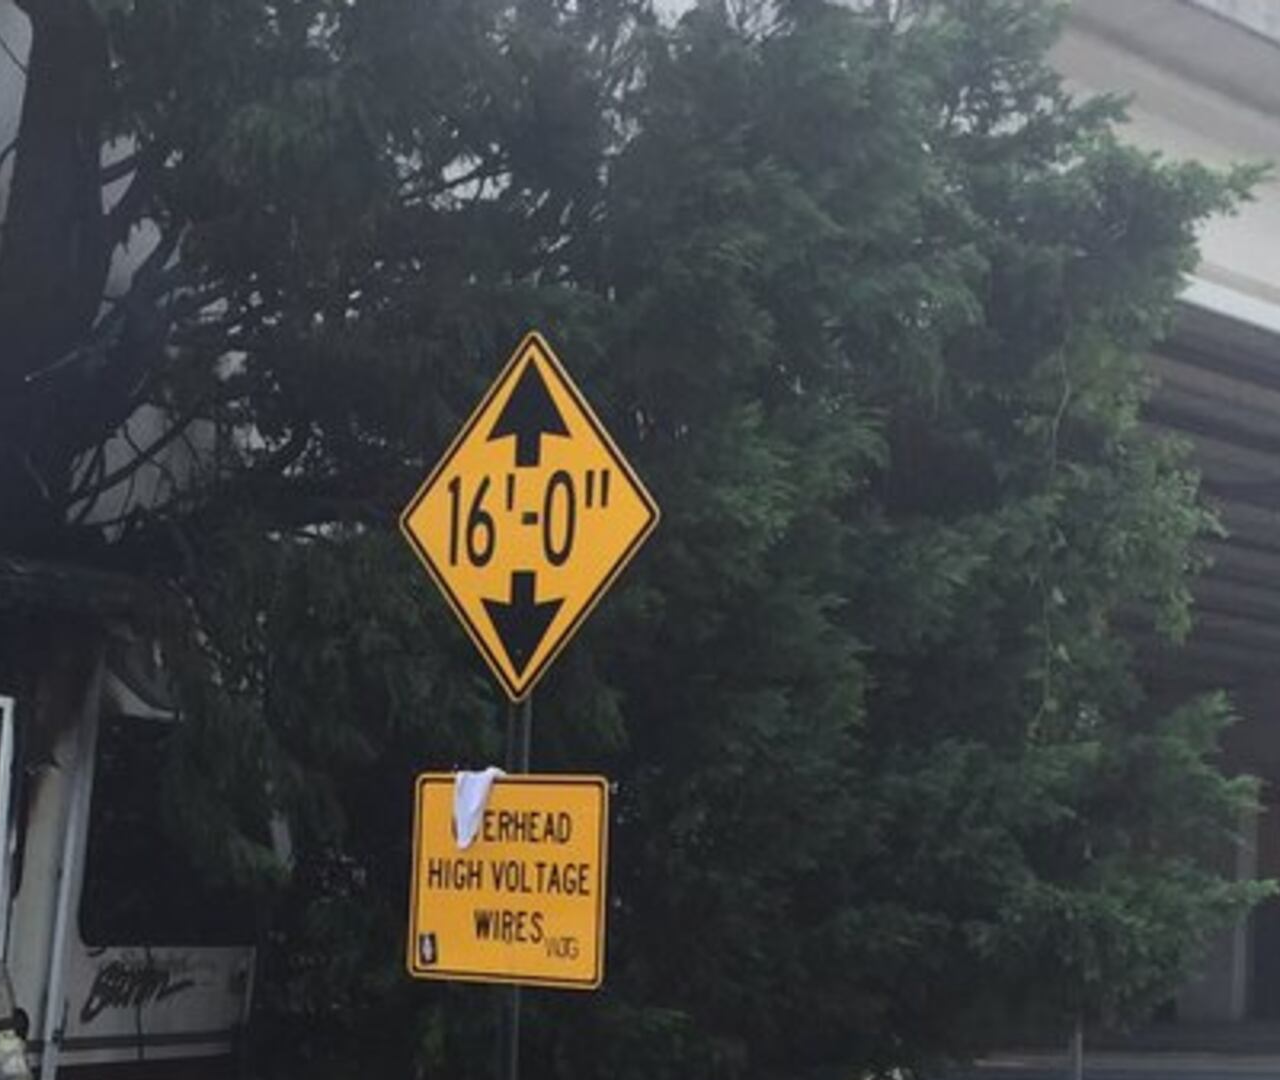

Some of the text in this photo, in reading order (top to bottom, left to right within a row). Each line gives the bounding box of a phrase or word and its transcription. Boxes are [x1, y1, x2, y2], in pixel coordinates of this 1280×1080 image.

[452, 811, 571, 843] ERHEAD
[428, 858, 590, 896] HIGH VOLTAGE
[473, 909, 545, 944] WIRES
